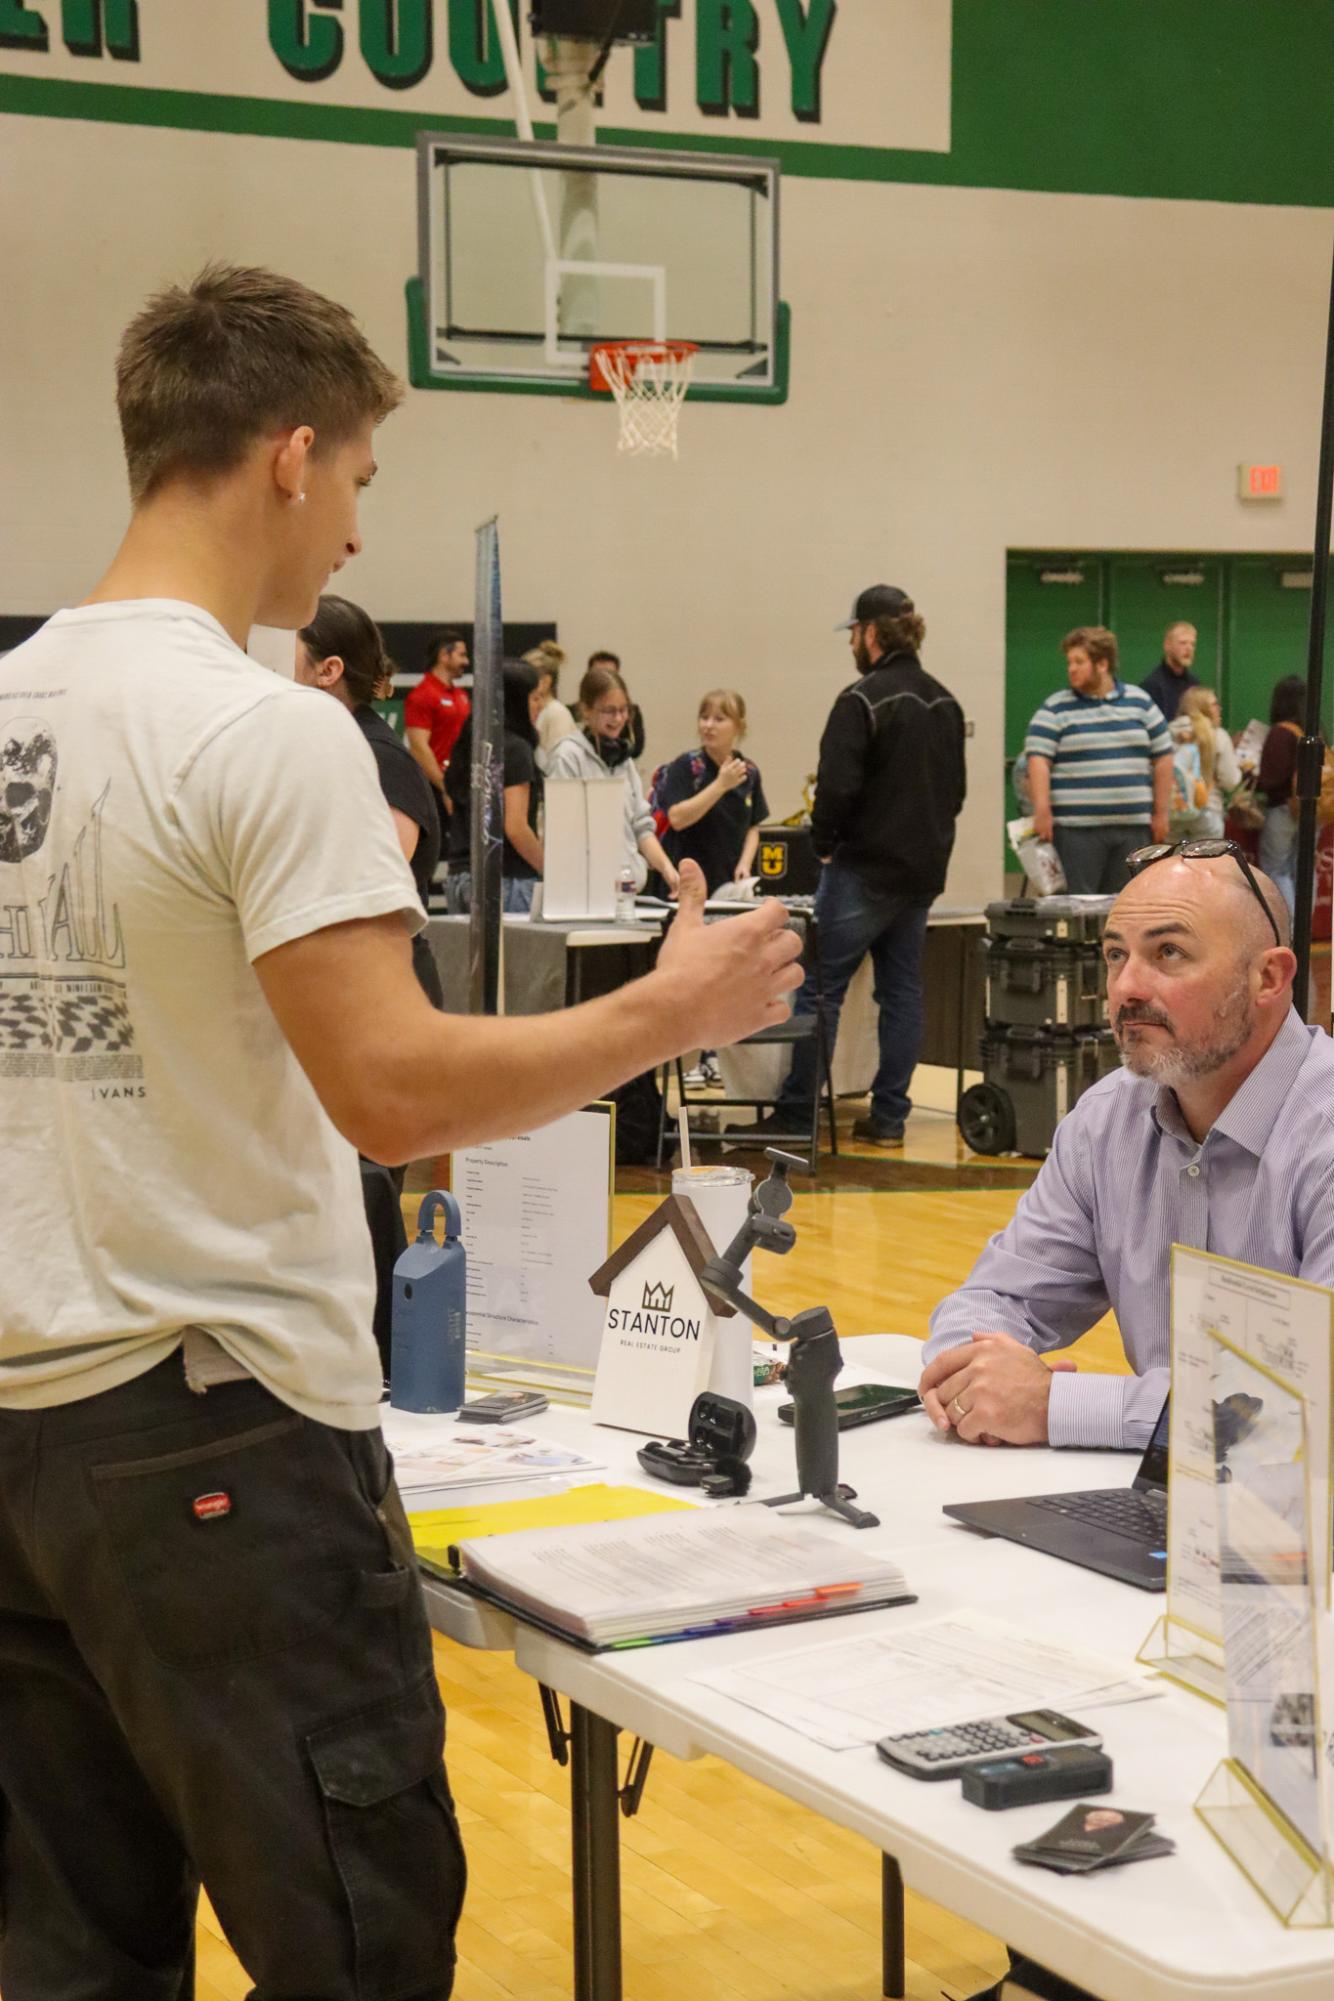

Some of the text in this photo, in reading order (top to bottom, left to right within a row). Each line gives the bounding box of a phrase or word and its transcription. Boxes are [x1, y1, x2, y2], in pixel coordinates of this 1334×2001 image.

[267, 0, 837, 124] COUTRY
[98, 1086, 147, 1100] VANS
[608, 1308, 701, 1341] STANTON
[620, 1339, 681, 1354] REAL ESTATE GROUP
